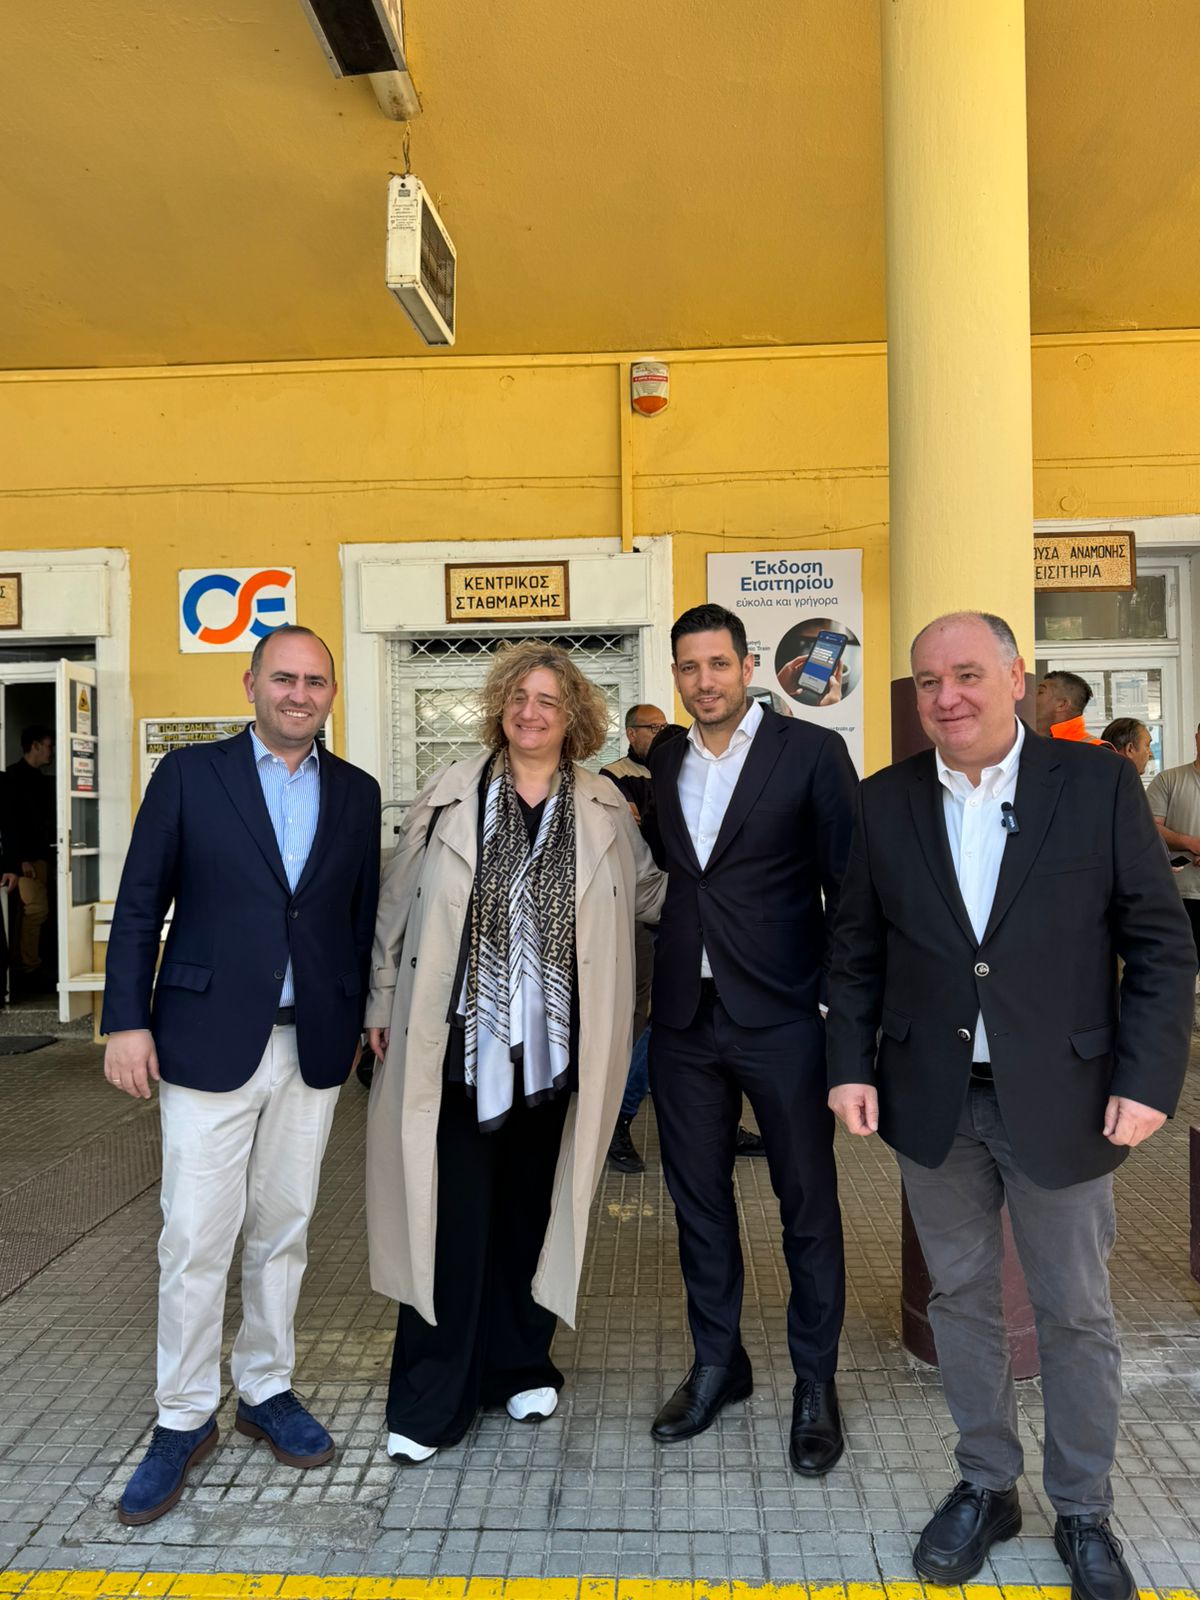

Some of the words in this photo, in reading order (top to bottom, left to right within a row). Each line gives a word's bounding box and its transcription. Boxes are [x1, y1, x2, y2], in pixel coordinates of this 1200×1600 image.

[1034, 546, 1060, 560] ΟΥΣΑ
[1070, 544, 1126, 559] ΑΝΑΜΟΝΗΣ
[751, 560, 823, 576] Έκδοση
[1035, 564, 1102, 580] ΕΙΣΙΤΗΡΙΑ
[464, 575, 550, 590] ΚΕΝΤΡΙΚΟΣ
[740, 574, 834, 593] Εισιτηρίου
[456, 594, 561, 610] ΣΤΑΘΜΑΡΧΗΣ
[736, 597, 773, 608] εύκολα
[775, 599, 792, 607] και
[794, 596, 839, 608] γρήγορα
